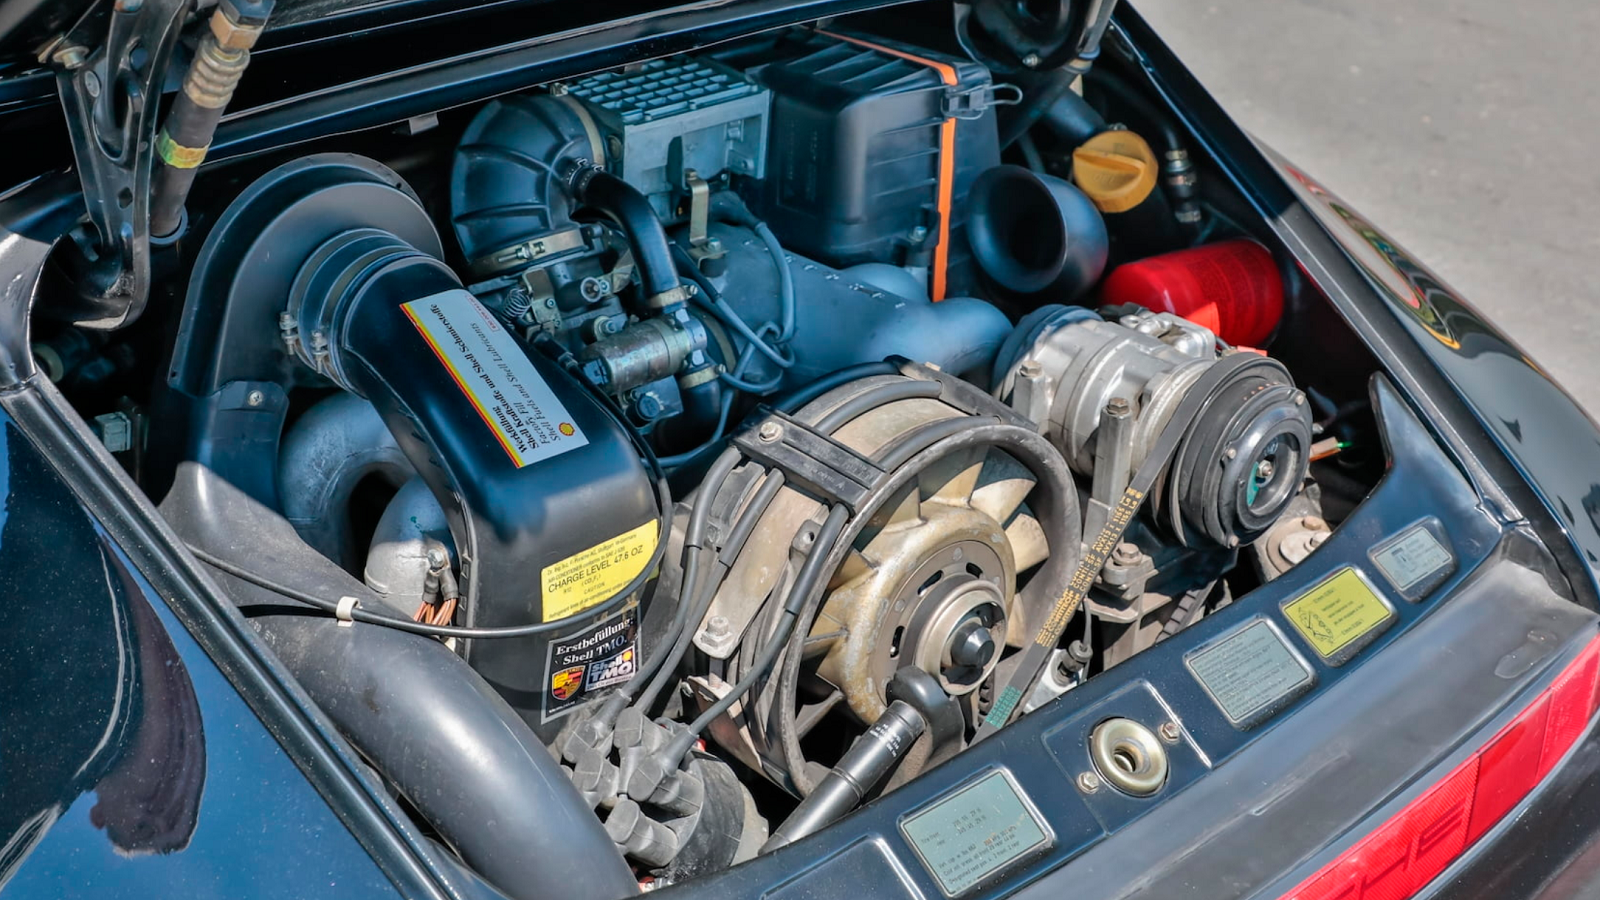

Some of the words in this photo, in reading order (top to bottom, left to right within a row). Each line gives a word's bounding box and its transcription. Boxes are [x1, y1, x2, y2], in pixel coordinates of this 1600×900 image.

[431, 304, 469, 354] Schmierstoffe
[470, 323, 502, 365] Lubricants
[465, 353, 484, 374] Shell
[498, 363, 518, 382] Shell
[480, 374, 495, 390] und
[514, 384, 530, 399] and
[493, 390, 524, 427] Kraftstoffe
[513, 402, 528, 414] Fill
[526, 400, 546, 420] Fuels
[492, 406, 527, 453] Werkfüllung
[521, 426, 540, 449] Shell
[527, 416, 550, 444] Factory
[543, 420, 561, 442] Shell
[548, 570, 584, 593] CHARGE
[586, 560, 611, 576] LEVEL
[614, 551, 629, 563] 47.6
[631, 545, 643, 556] OZ
[562, 651, 593, 665] Shell
[592, 656, 622, 671] Shell
[591, 664, 632, 681] TMO
